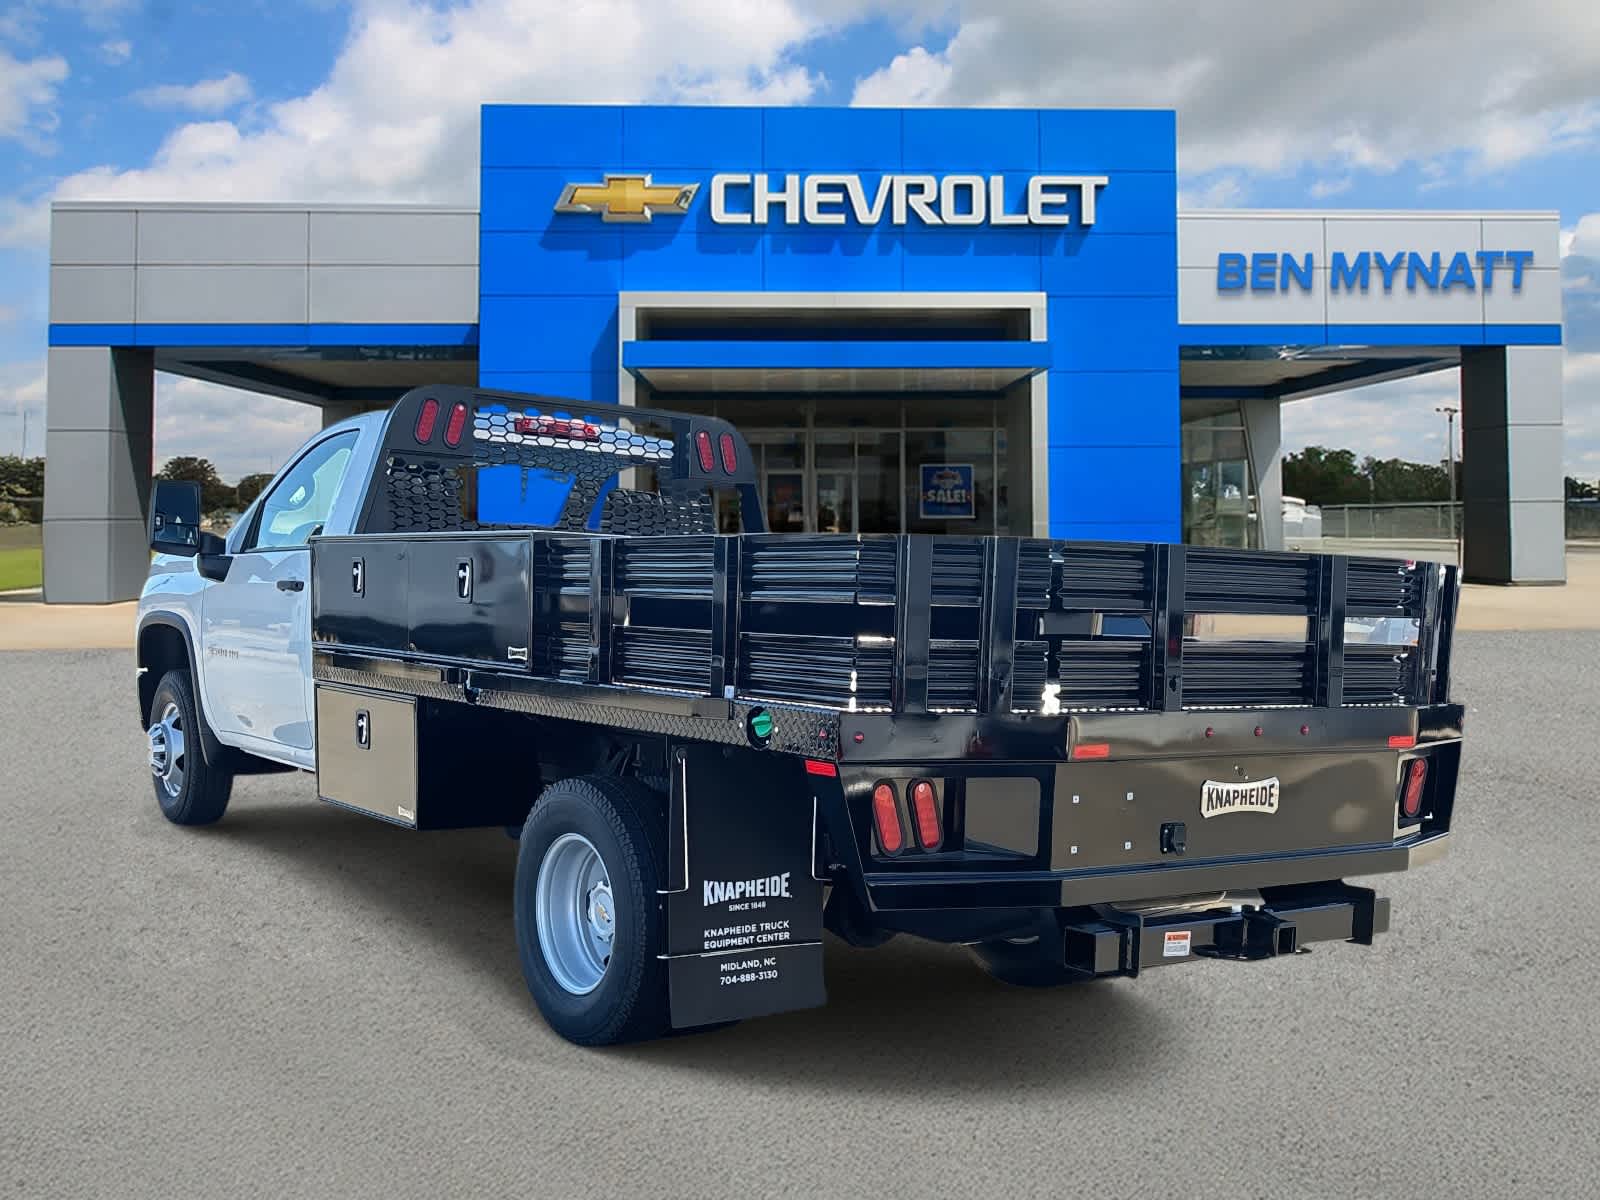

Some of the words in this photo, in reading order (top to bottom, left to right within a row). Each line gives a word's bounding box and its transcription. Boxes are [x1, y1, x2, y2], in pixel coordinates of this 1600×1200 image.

[710, 173, 1109, 226] CHEVROLET
[1217, 252, 1313, 291] BEN
[1330, 250, 1534, 291] MYNATT
[1206, 783, 1275, 812] KNAPHEIDE
[703, 871, 791, 907] KNAPHEIDE
[728, 902, 750, 912] SINCE
[703, 924, 757, 938] KNAPHEIDE
[759, 920, 790, 932] TRUCK
[703, 935, 754, 950] EQUIPMENT
[756, 931, 790, 944] CENTER
[720, 959, 762, 972] MIDLAND,
[763, 957, 777, 967] NC
[719, 970, 778, 985] 704-888-3130
